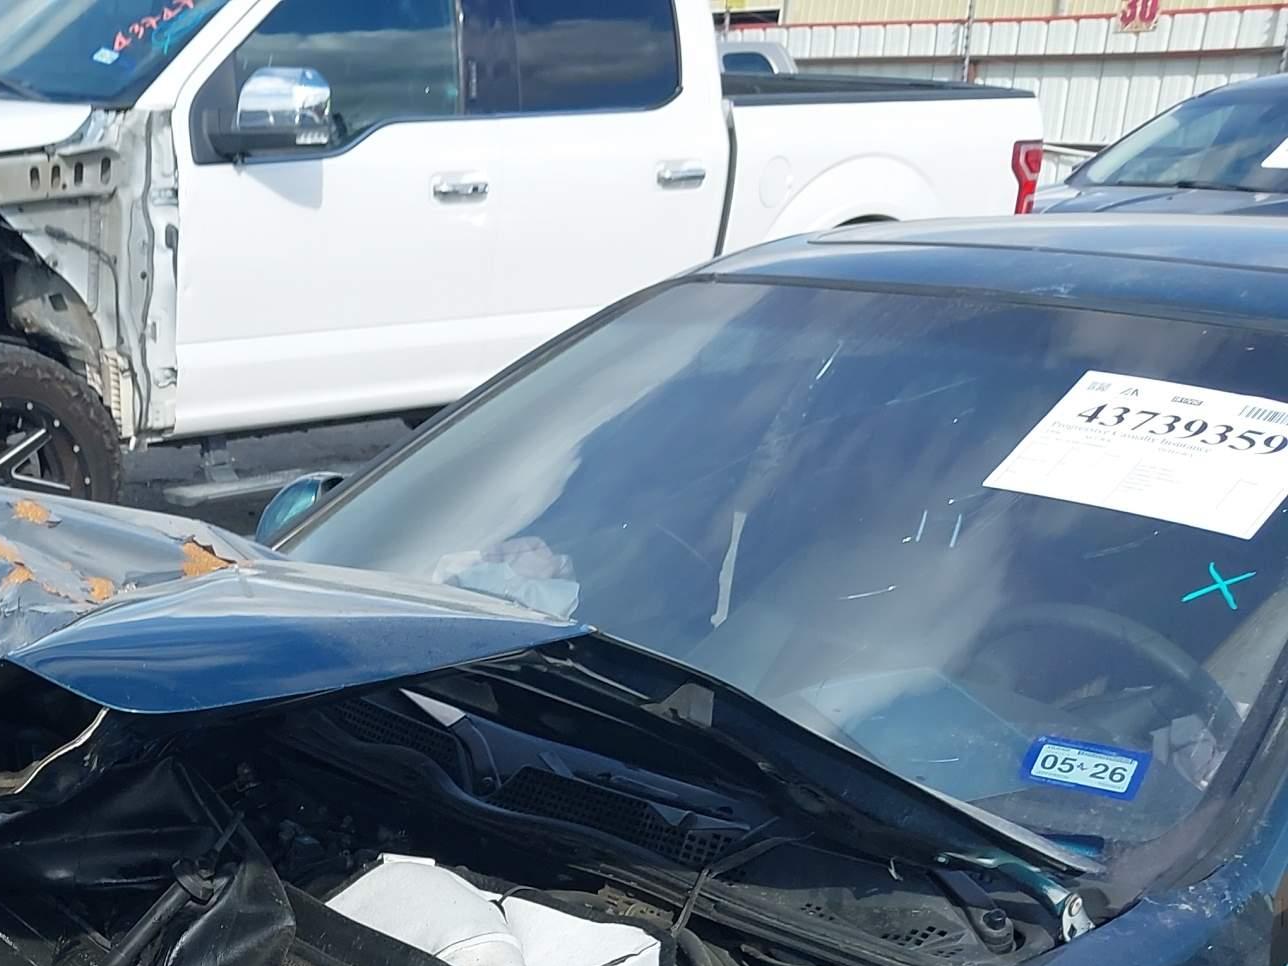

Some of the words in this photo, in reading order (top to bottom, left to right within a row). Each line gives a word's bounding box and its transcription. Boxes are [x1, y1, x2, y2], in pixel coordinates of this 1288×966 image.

[1076, 403, 1288, 455] 43739359
[1040, 754, 1077, 773] 05
[1089, 763, 1128, 783] 26
